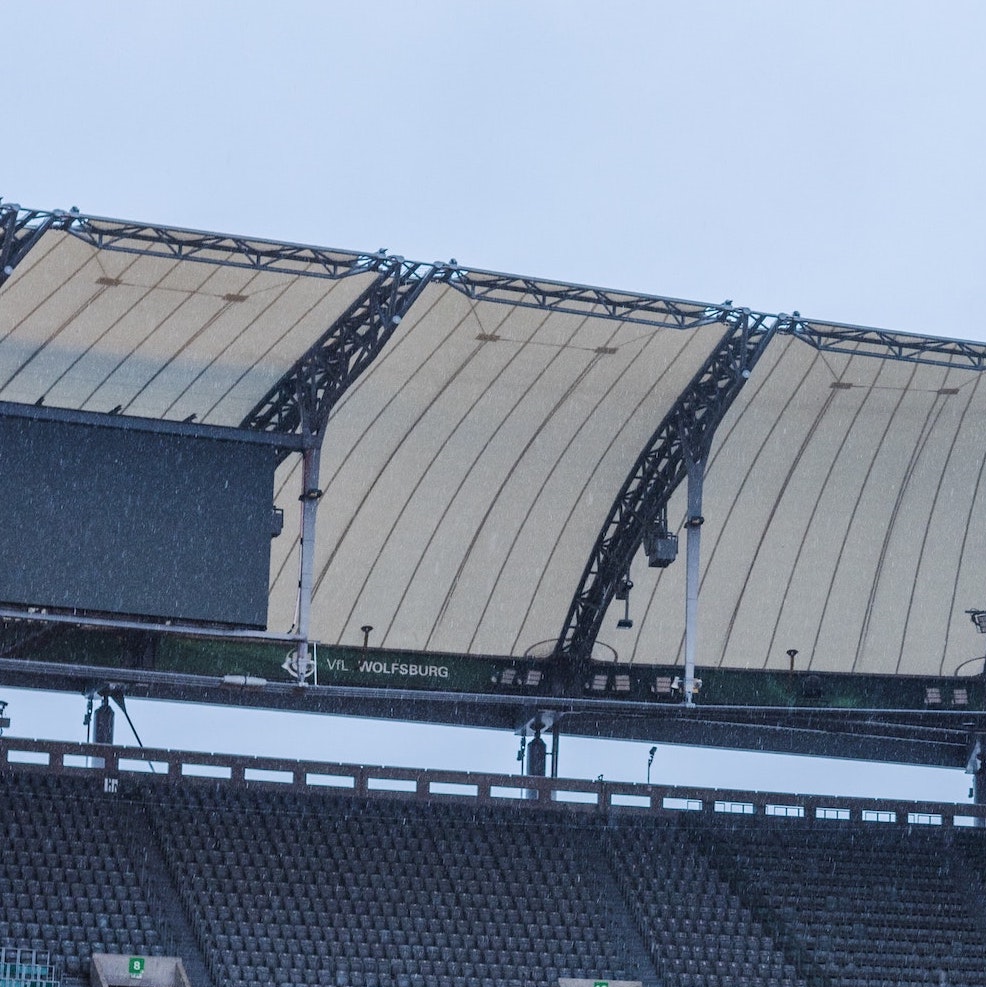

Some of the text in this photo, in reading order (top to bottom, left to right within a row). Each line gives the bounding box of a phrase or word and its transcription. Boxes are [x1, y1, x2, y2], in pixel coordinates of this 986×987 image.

[326, 658, 449, 678] VfL WOLFSBURG
[133, 960, 141, 970] 8
